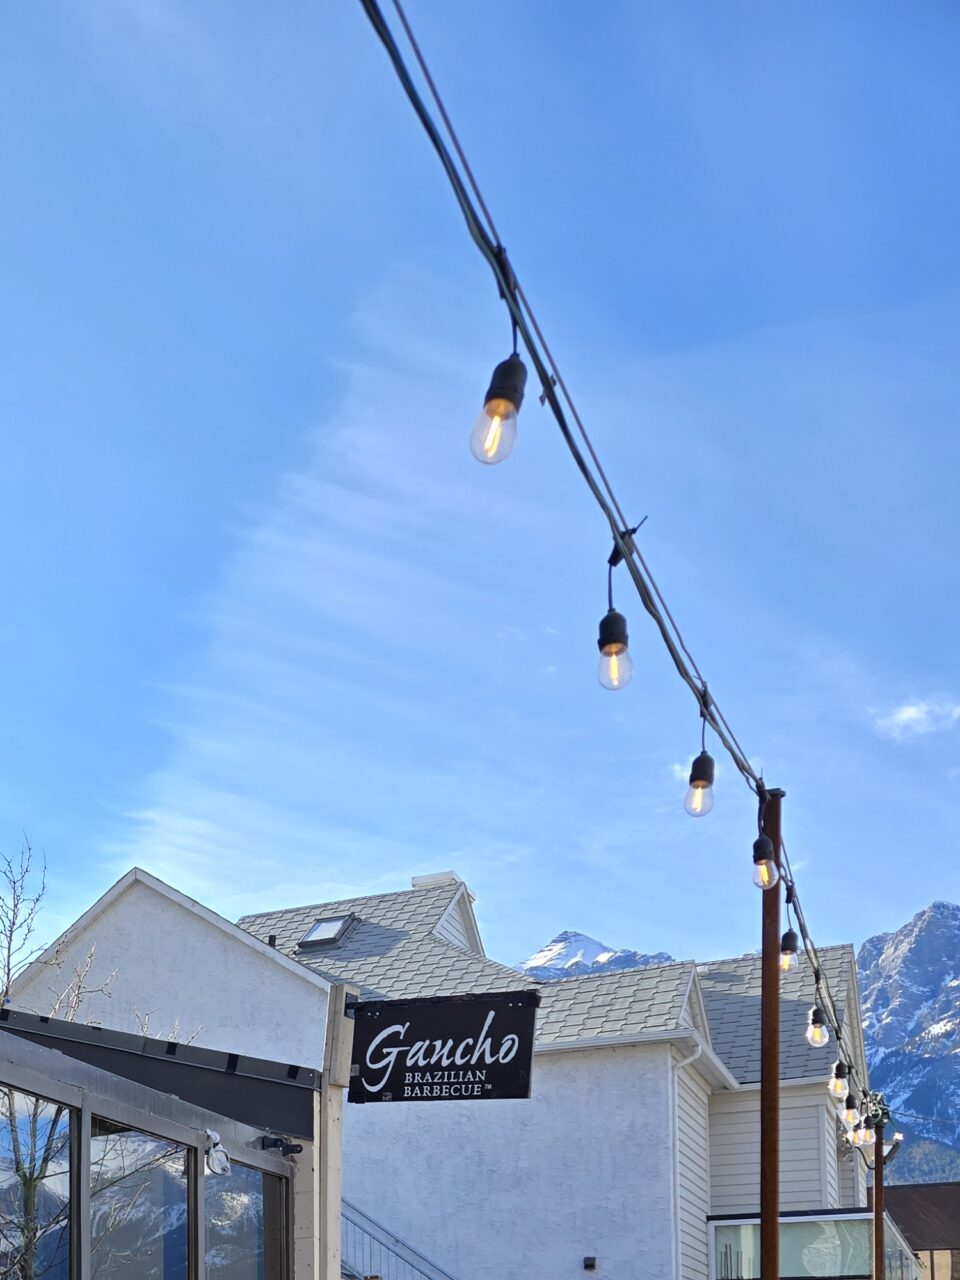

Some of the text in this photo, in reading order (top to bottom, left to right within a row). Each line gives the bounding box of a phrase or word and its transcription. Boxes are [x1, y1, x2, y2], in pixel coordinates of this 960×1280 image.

[361, 1010, 519, 1093] Gaucho
[404, 1070, 487, 1084] BRAZILIAN
[403, 1084, 482, 1097] BARBECUE
